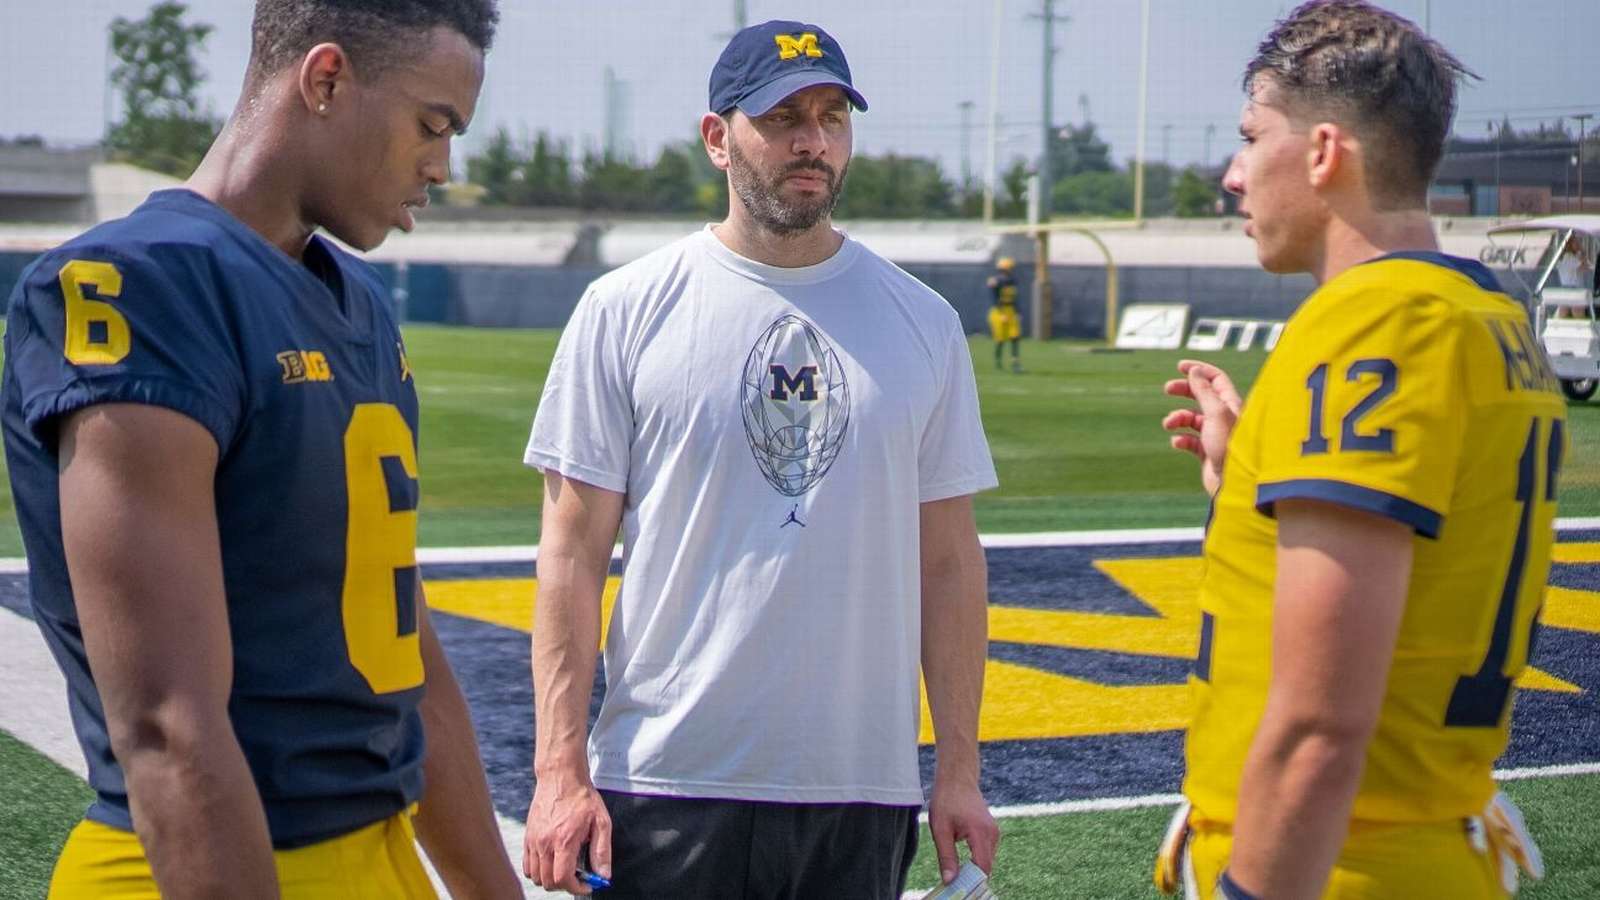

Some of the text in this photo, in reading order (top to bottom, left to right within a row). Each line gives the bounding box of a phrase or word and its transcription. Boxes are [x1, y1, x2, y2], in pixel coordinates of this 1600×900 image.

[774, 33, 824, 60] M
[59, 259, 131, 365] 6
[769, 364, 818, 401] M
[1300, 358, 1398, 457] 12
[343, 403, 425, 694] 6
